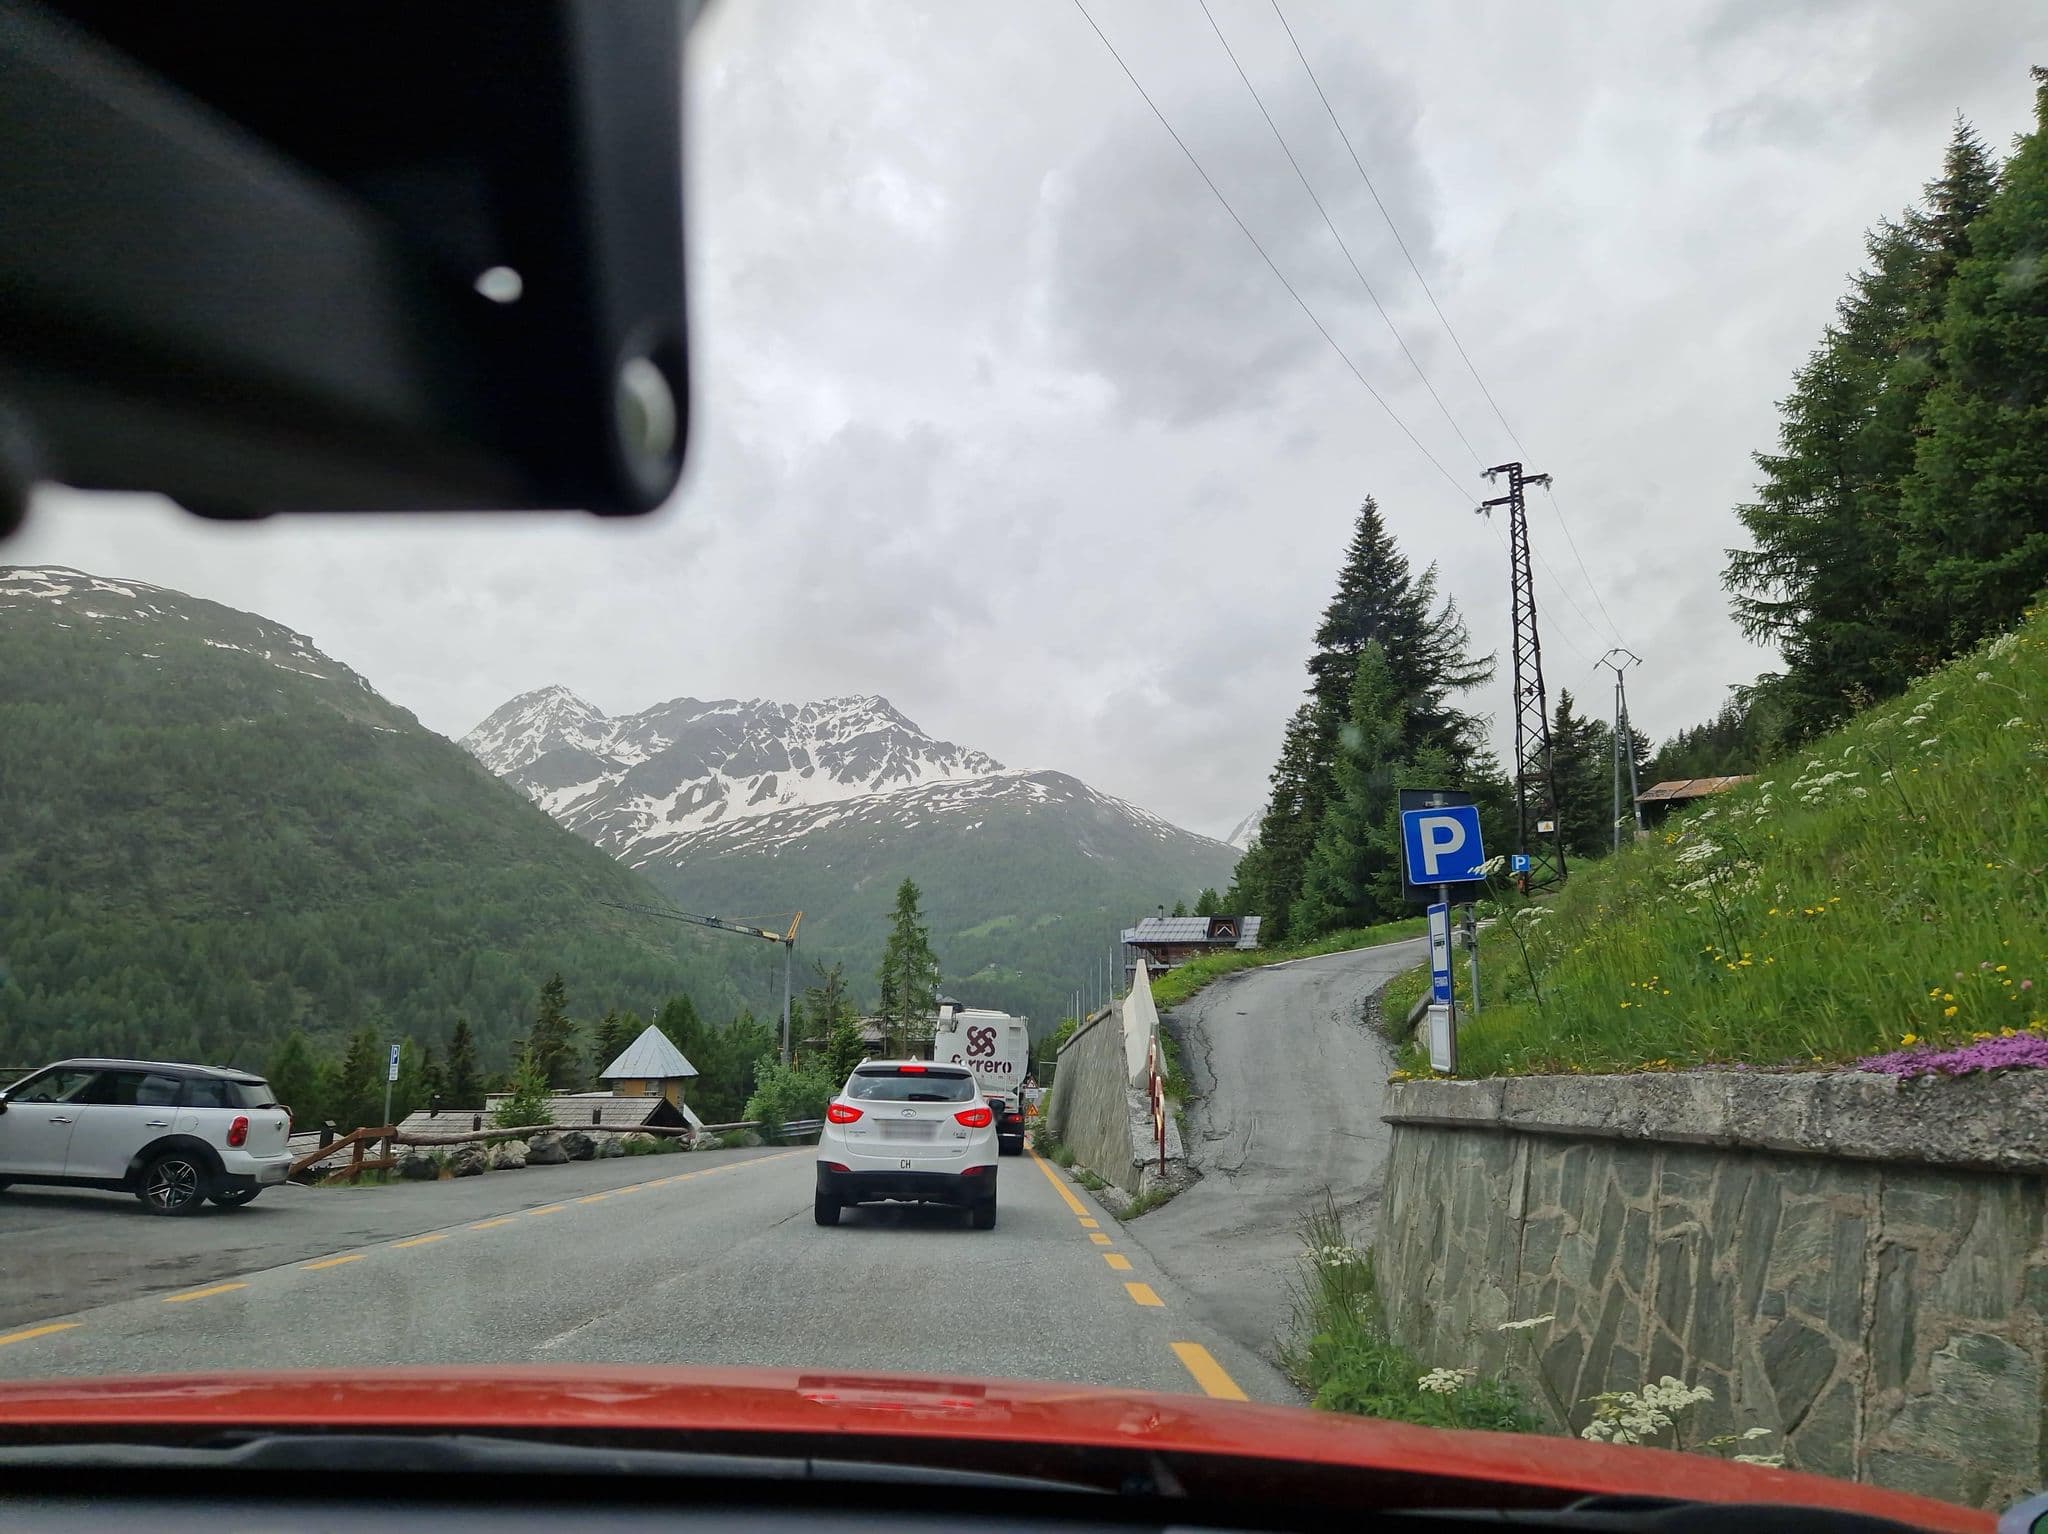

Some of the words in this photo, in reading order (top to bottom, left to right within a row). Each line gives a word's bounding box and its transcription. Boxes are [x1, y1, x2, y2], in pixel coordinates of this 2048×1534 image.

[1419, 816, 1466, 875] P
[1515, 856, 1526, 870] P
[950, 1054, 1012, 1074] frrero
[900, 1159, 911, 1169] CH
